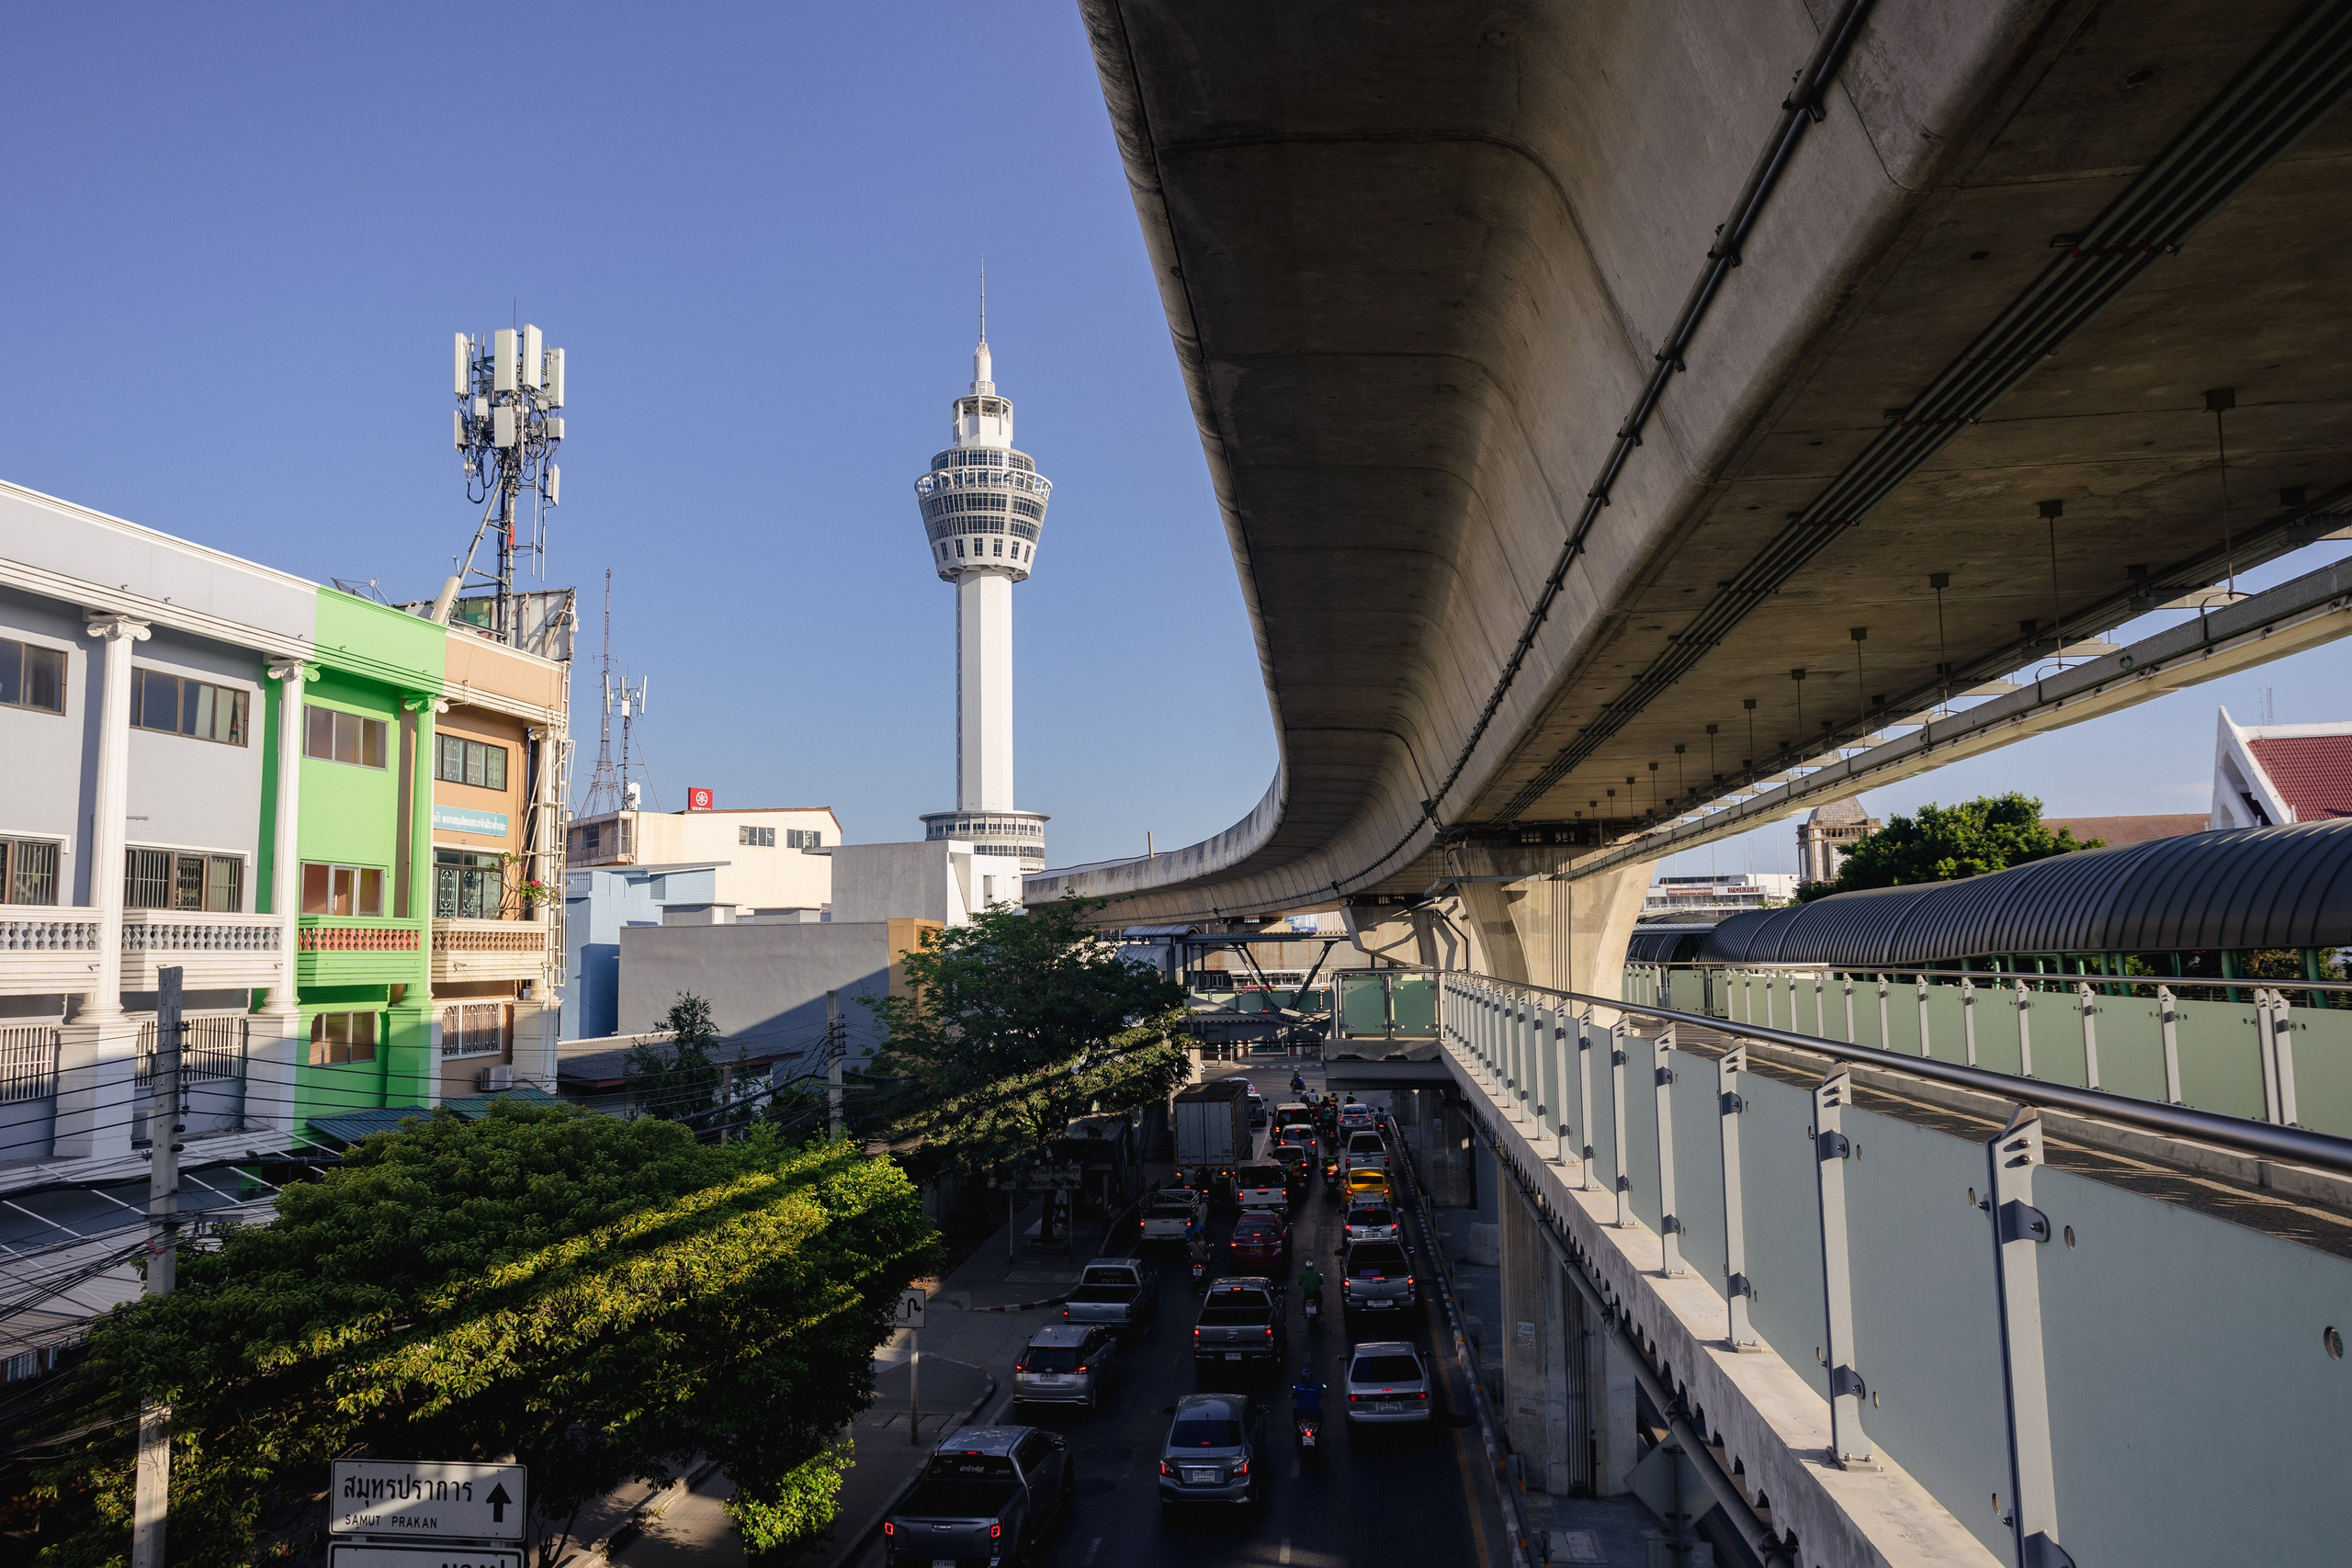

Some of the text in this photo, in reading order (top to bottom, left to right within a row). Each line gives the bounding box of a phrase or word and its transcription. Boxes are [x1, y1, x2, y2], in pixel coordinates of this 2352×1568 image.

[1518, 1324, 1534, 1332] P.208
[344, 1473, 473, 1507] สมุทรปราการ
[345, 1514, 437, 1529] SAMUT PRAKAN
